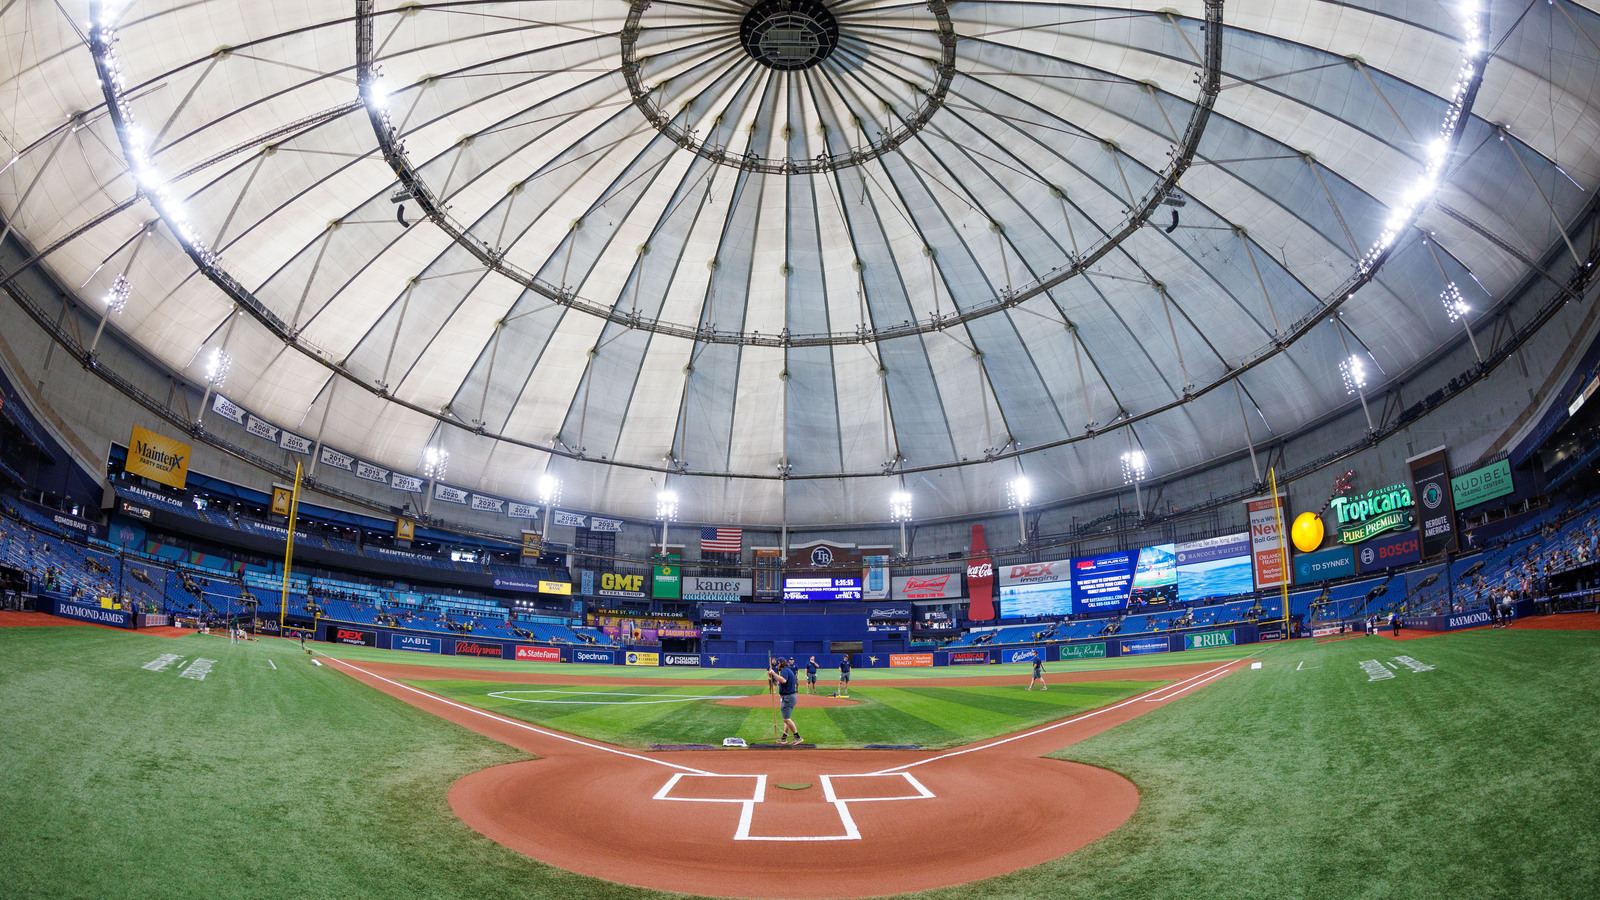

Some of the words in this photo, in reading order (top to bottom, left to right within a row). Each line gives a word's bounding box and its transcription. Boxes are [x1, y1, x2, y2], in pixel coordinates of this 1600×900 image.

[216, 407, 239, 422] CHAMPIONS
[221, 403, 236, 415] 2008
[249, 426, 273, 440] CHAMPIONS
[254, 423, 270, 434] 2008
[283, 443, 306, 452] CHAMPIONS
[288, 439, 303, 448] 2010
[134, 440, 184, 472] MaintenX
[330, 455, 344, 463] 2011
[140, 458, 156, 468] PARTY
[156, 463, 169, 472] DECK
[365, 468, 380, 476] 2013
[1454, 467, 1510, 493] AUDIBEL
[1376, 483, 1405, 494] ORIGINAL
[1461, 488, 1481, 497] HEARING
[1483, 479, 1504, 490] CENTERS
[130, 486, 183, 507] MAINTENX.COM
[1330, 488, 1411, 524] Tropicana
[54, 515, 73, 527] SOMOS
[74, 520, 87, 530] RAYS
[1343, 528, 1365, 542] PURE
[1365, 514, 1403, 534] PREMIUM
[1425, 516, 1447, 528] REROUTE
[1253, 523, 1282, 536] New
[1425, 524, 1450, 537] AMERICAS
[380, 548, 432, 560] MAINTENX.COM
[1188, 550, 1216, 559] HANCOCK
[1218, 546, 1247, 554] WHITNEY
[1379, 540, 1418, 559] BOSCH
[1322, 558, 1349, 569] SYNNEX
[1010, 563, 1054, 578] DEX
[601, 573, 644, 591] GMF
[695, 578, 740, 591] kane's
[908, 580, 945, 588] Budweiser
[60, 603, 99, 620] RAYMOND
[99, 611, 124, 623] JAMES
[1450, 612, 1487, 627] RAYMOND
[337, 630, 363, 640] DEX
[402, 637, 431, 646] JABIL
[1203, 633, 1228, 646] RIPA
[456, 642, 482, 656] Bally
[482, 647, 501, 655] SPORTS
[1062, 648, 1082, 658] Quality
[1083, 645, 1103, 656] Roofing
[577, 652, 608, 661] Spectrum
